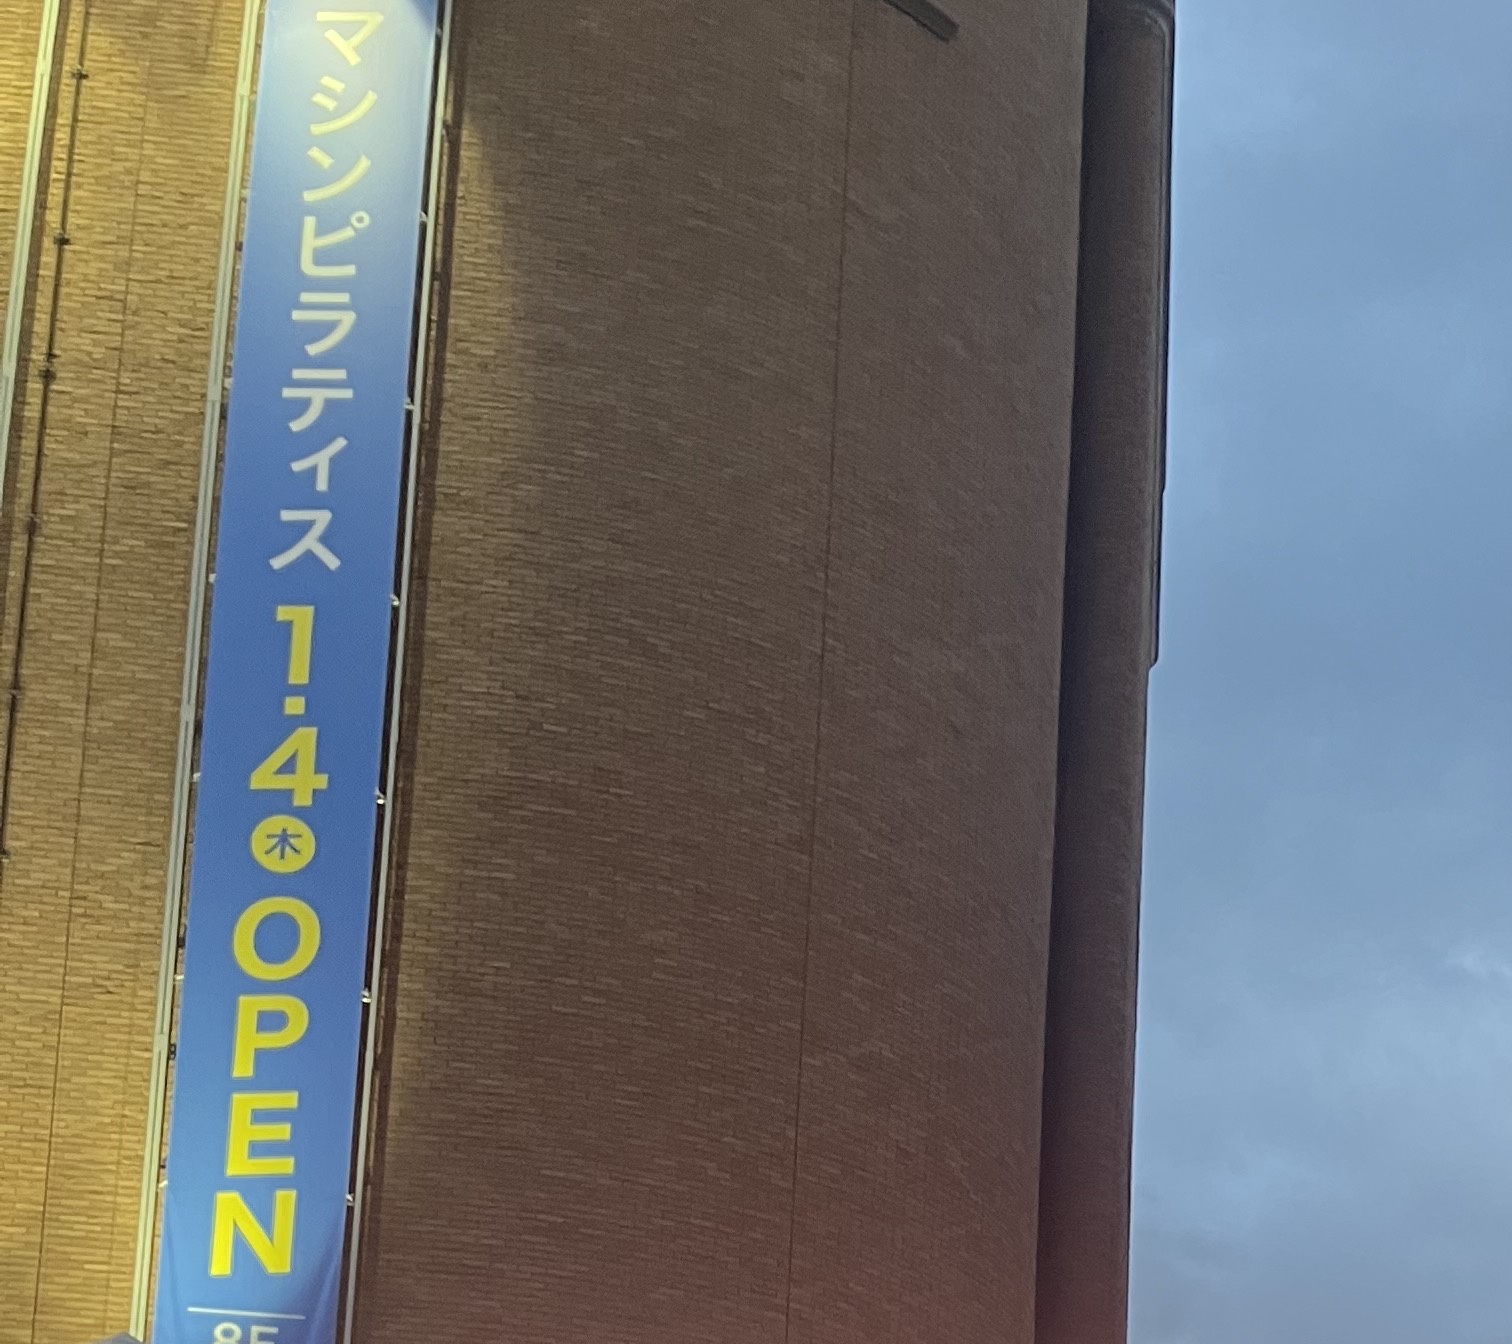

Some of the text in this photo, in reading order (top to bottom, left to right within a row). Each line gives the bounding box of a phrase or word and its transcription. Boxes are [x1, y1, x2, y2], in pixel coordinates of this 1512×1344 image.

[269, 9, 383, 572] マシンピラティス
[207, 896, 322, 1277] OPEN
